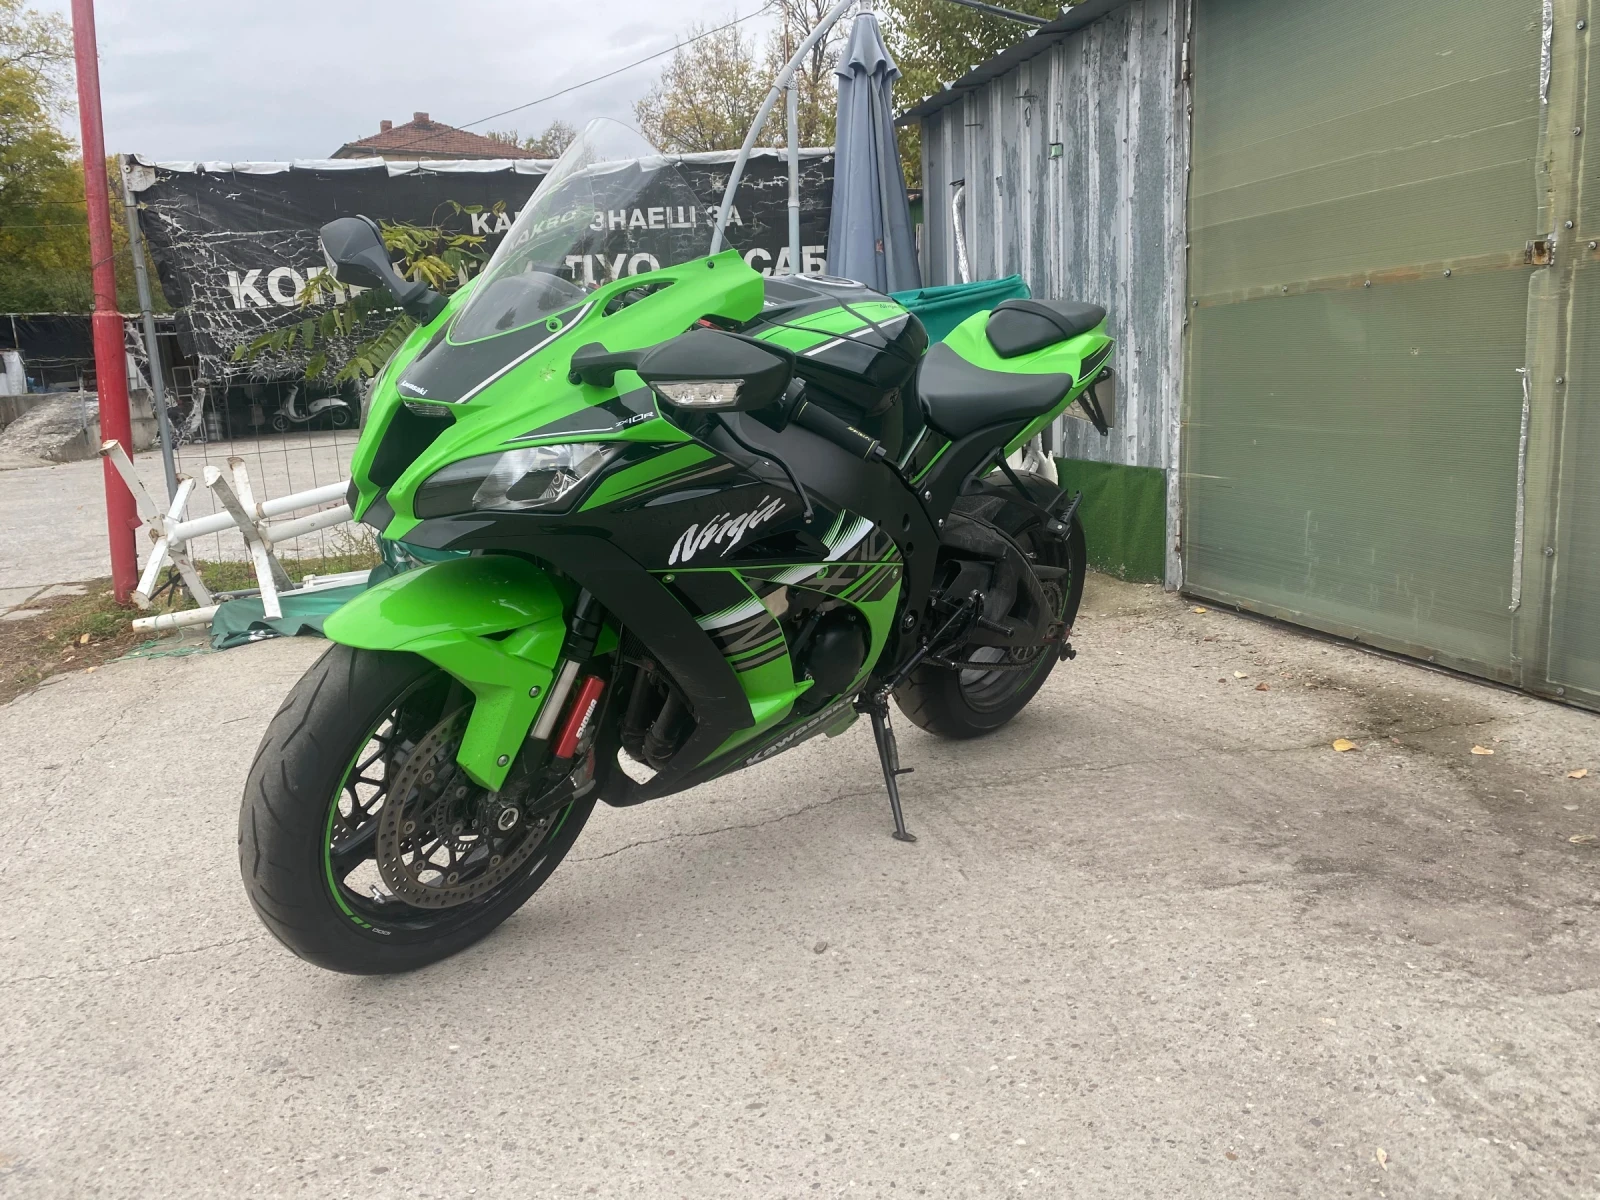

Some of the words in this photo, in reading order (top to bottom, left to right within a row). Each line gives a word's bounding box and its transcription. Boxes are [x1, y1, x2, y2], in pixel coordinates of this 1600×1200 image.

[589, 206, 697, 231] ЗНАЕШ
[706, 205, 743, 228] ЗА
[668, 495, 786, 565] Ninja
[576, 698, 597, 739] SHOWA
